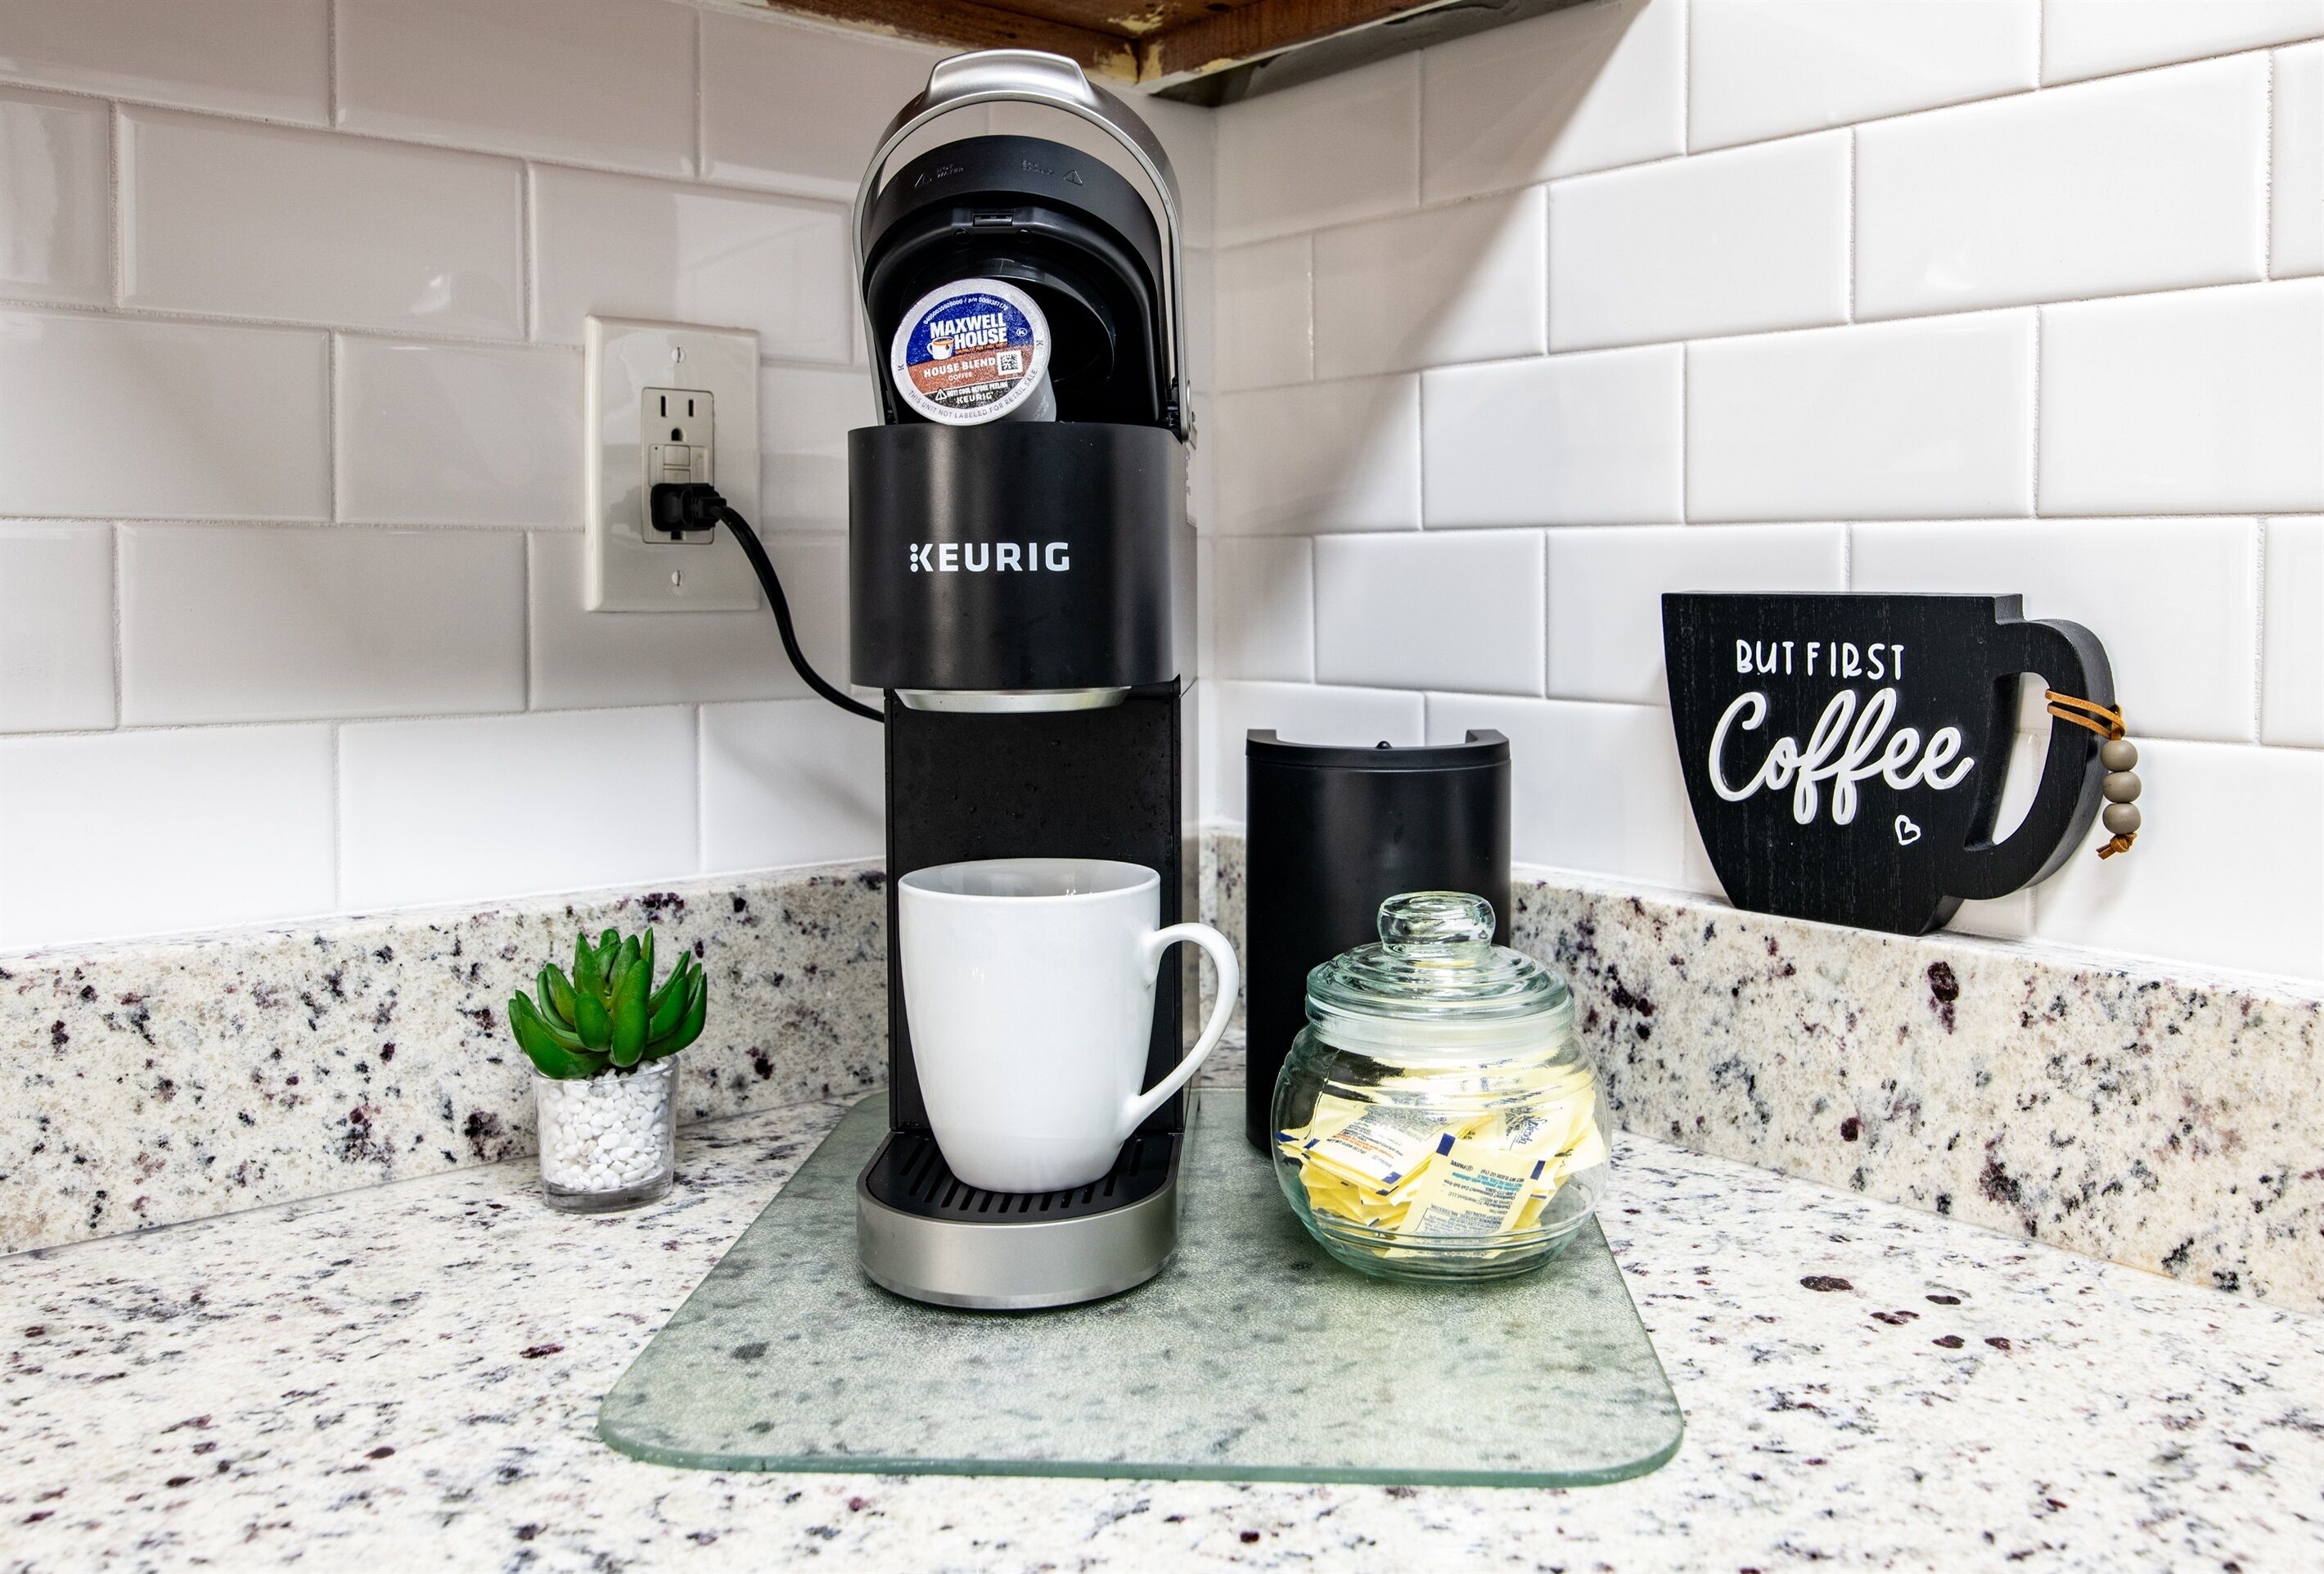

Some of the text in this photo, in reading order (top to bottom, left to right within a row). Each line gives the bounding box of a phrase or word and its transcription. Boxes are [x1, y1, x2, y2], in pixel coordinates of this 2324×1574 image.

[930, 313, 1007, 339] MAXWELL
[954, 327, 1007, 350] HOUSE
[923, 358, 996, 378] HOUSE BLEND
[948, 372, 973, 381] COFFEE
[908, 390, 922, 404] THIS
[922, 402, 937, 413] UNIT
[954, 409, 987, 418] LABELED
[989, 402, 1003, 413] FOR
[1005, 386, 1026, 404] RETAIL
[1025, 370, 1038, 386] SALE
[910, 542, 1070, 572] KEURIG
[1736, 639, 1904, 680] BUT FIRST
[1709, 688, 1975, 825] Coffee
[1450, 1160, 1466, 1170] PARVE
